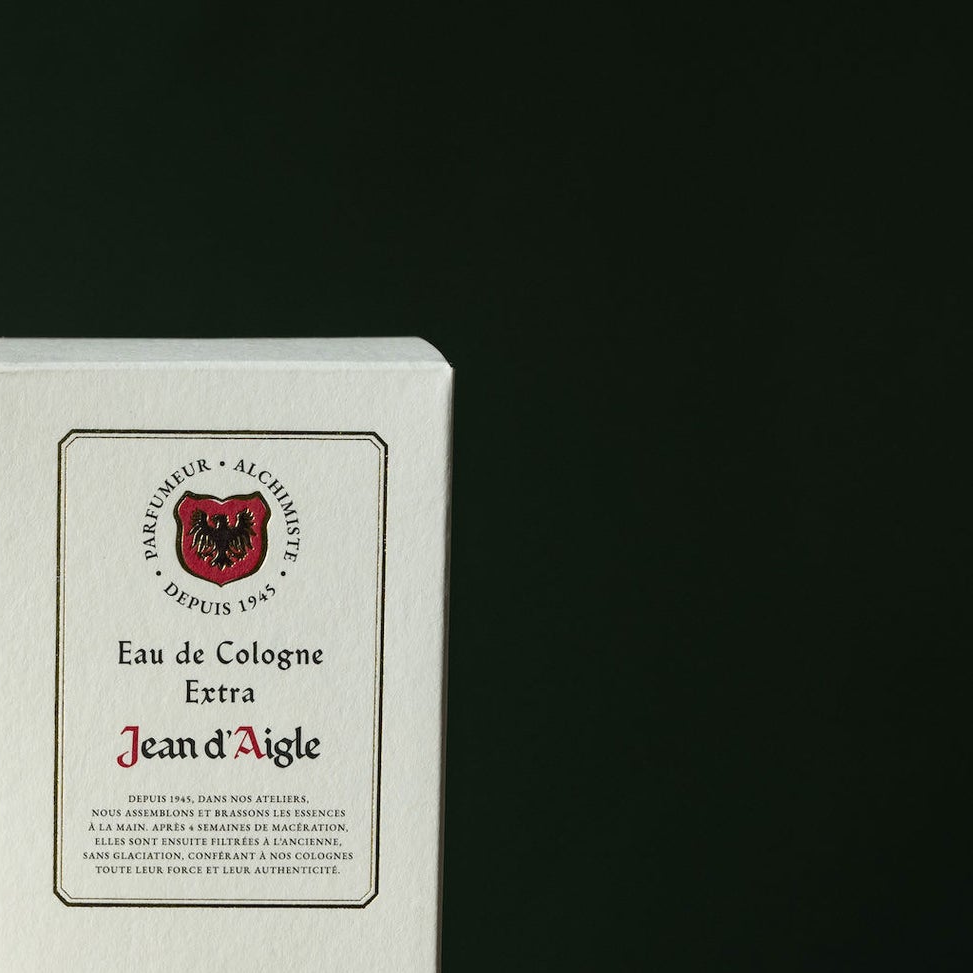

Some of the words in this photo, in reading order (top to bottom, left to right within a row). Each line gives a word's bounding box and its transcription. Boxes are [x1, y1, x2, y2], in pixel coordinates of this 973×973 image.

[143, 458, 211, 560] PARFUMEUR
[233, 458, 301, 562] ALCHIMISTE
[163, 581, 232, 616] DEPUIS
[239, 583, 276, 613] 1945
[117, 640, 164, 665] Eau
[175, 641, 204, 664] de
[216, 640, 324, 670] Cologne
[185, 679, 256, 705] Extra
[116, 725, 198, 769] Jean
[204, 726, 321, 768] d'Aigle
[128, 795, 167, 803] DEPUIS
[170, 795, 195, 804] 1945,
[198, 795, 227, 803] DANS
[230, 795, 252, 803] NOS
[255, 795, 309, 804] ATELIERS,
[92, 809, 122, 817] NOUS
[125, 809, 195, 817] ASSEMBLONS
[198, 809, 211, 817] ET
[215, 809, 270, 817] BRASSONS
[273, 809, 291, 817] LES
[294, 809, 346, 817] ESSENCES
[88, 822, 95, 831] À
[99, 823, 112, 832] LA
[116, 823, 148, 832] MAIN.
[152, 822, 185, 831] APRÈS
[197, 823, 251, 832] SEMAINES
[254, 823, 268, 832] DE
[272, 822, 349, 833] MACÉRATION,
[95, 838, 125, 846] ELLES
[129, 838, 158, 846] SONT
[161, 838, 207, 846] ENSUITE
[211, 837, 260, 846] FILTRÉES
[263, 836, 270, 846] À
[273, 838, 342, 847] L'ANCIENNE,
[83, 852, 110, 860] SANS
[113, 852, 185, 861] GLACIATION,
[188, 851, 256, 860] CONFÉRANT
[259, 851, 266, 860] À
[270, 852, 292, 860] NOS
[295, 852, 354, 860] COLOGNES
[95, 866, 132, 874] TOUTE
[135, 866, 164, 874] LEUR
[167, 866, 203, 874] FORCE
[206, 866, 219, 874] ET
[222, 866, 251, 874] LEUR
[254, 865, 340, 874] AUTHENTICITÉ.
